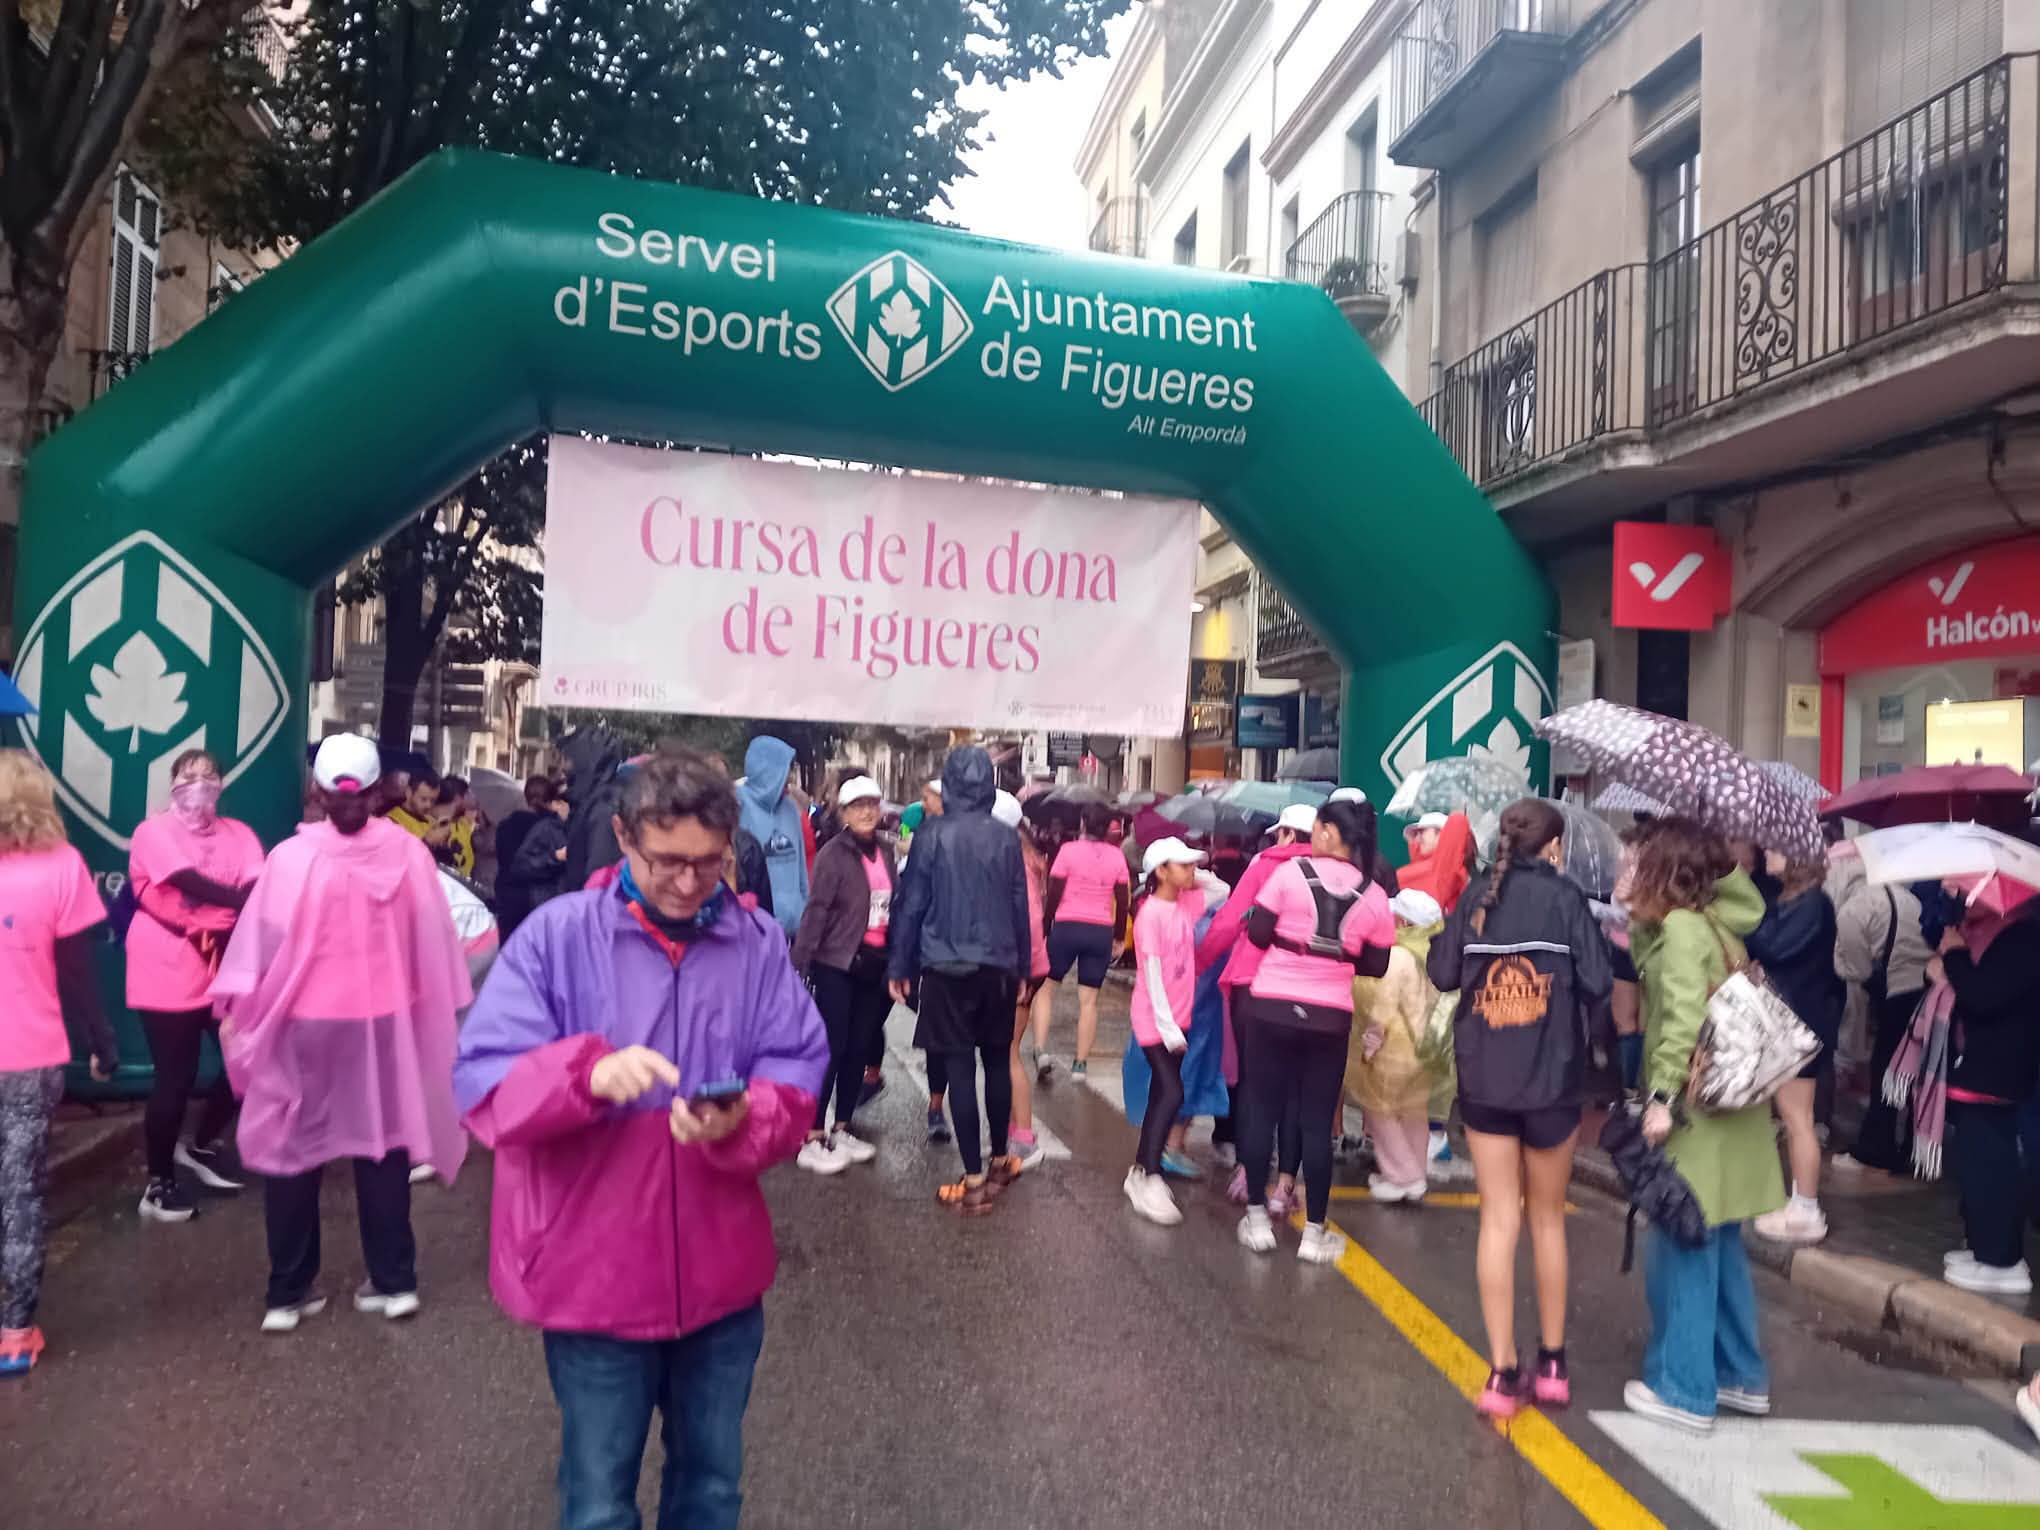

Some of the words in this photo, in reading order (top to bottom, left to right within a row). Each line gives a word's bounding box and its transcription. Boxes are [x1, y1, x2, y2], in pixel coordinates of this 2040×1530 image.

[596, 212, 775, 281] Servei
[554, 275, 822, 361] d’Esports
[982, 275, 1257, 351] Ajuntament
[980, 331, 1042, 382] de
[1061, 344, 1255, 412] Figueres
[1127, 414, 1156, 434] Alt
[1160, 418, 1248, 445] Empordà
[640, 495, 821, 578] Cursa
[839, 514, 906, 585] de
[923, 521, 968, 592] la
[986, 530, 1117, 603] dona
[722, 587, 793, 657] de
[813, 594, 1040, 680] Figueres
[1926, 605, 2030, 648] Halcón
[1490, 983, 1537, 1001] TRAIL
